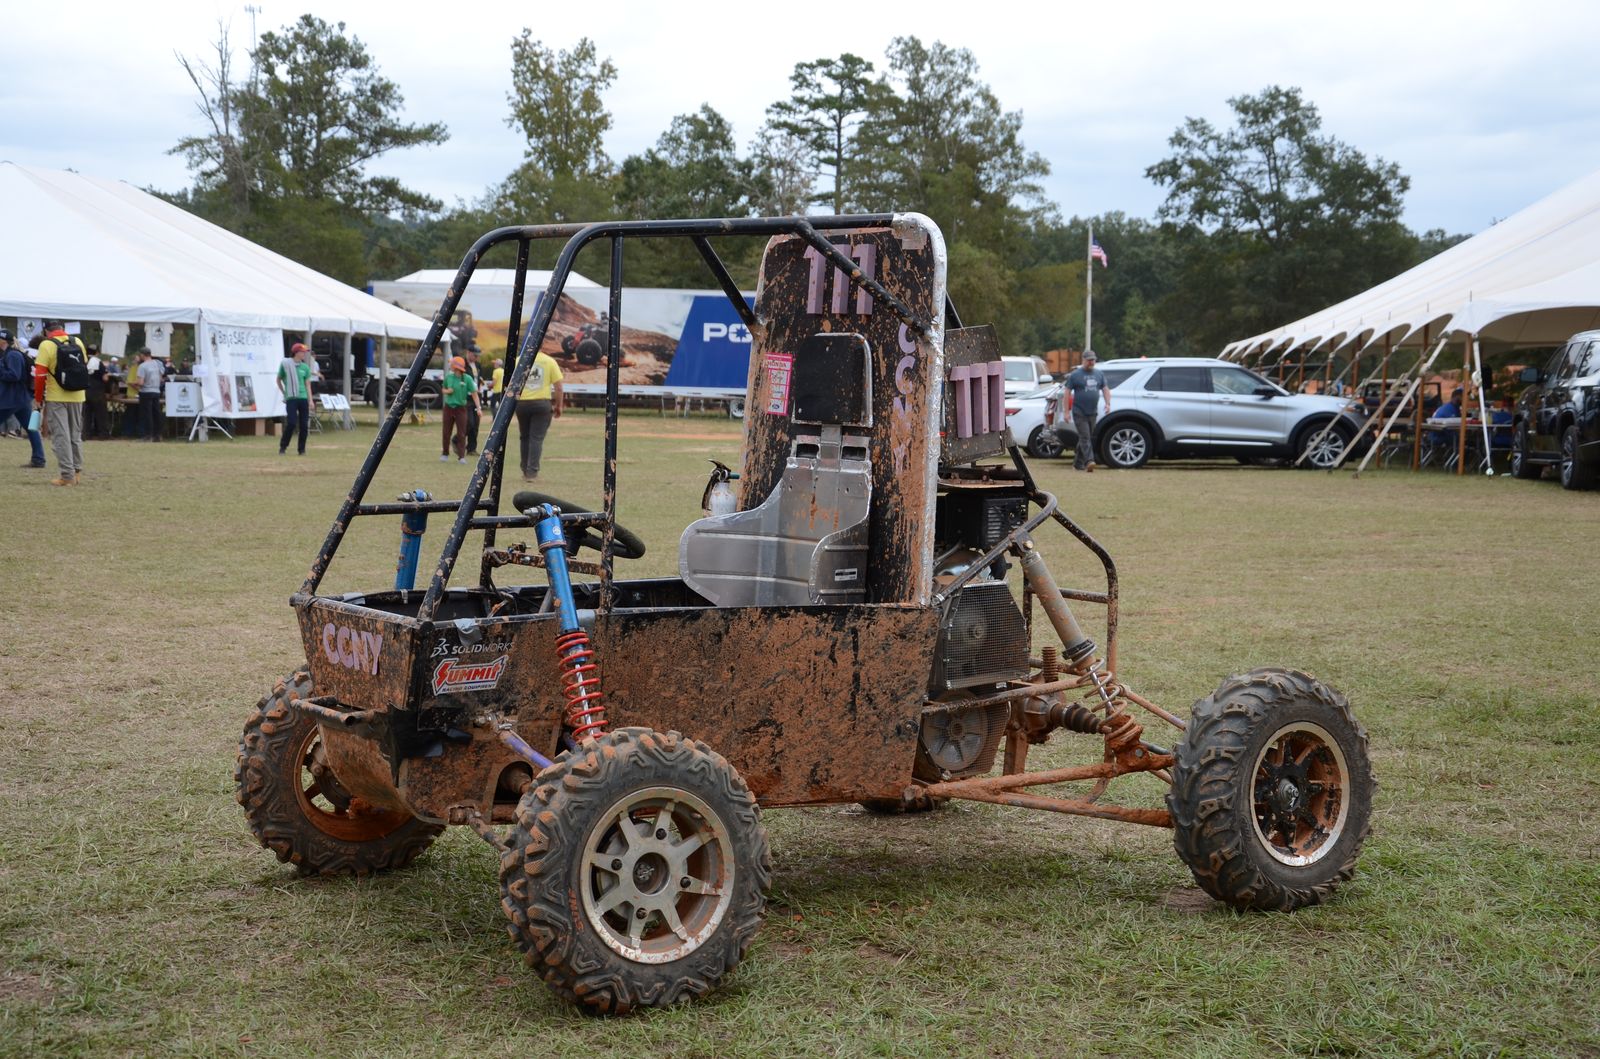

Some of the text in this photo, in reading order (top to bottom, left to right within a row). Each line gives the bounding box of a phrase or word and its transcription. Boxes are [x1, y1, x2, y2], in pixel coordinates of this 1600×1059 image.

[803, 243, 877, 315] 111
[949, 360, 1006, 438] 111
[322, 622, 383, 676] CCNY
